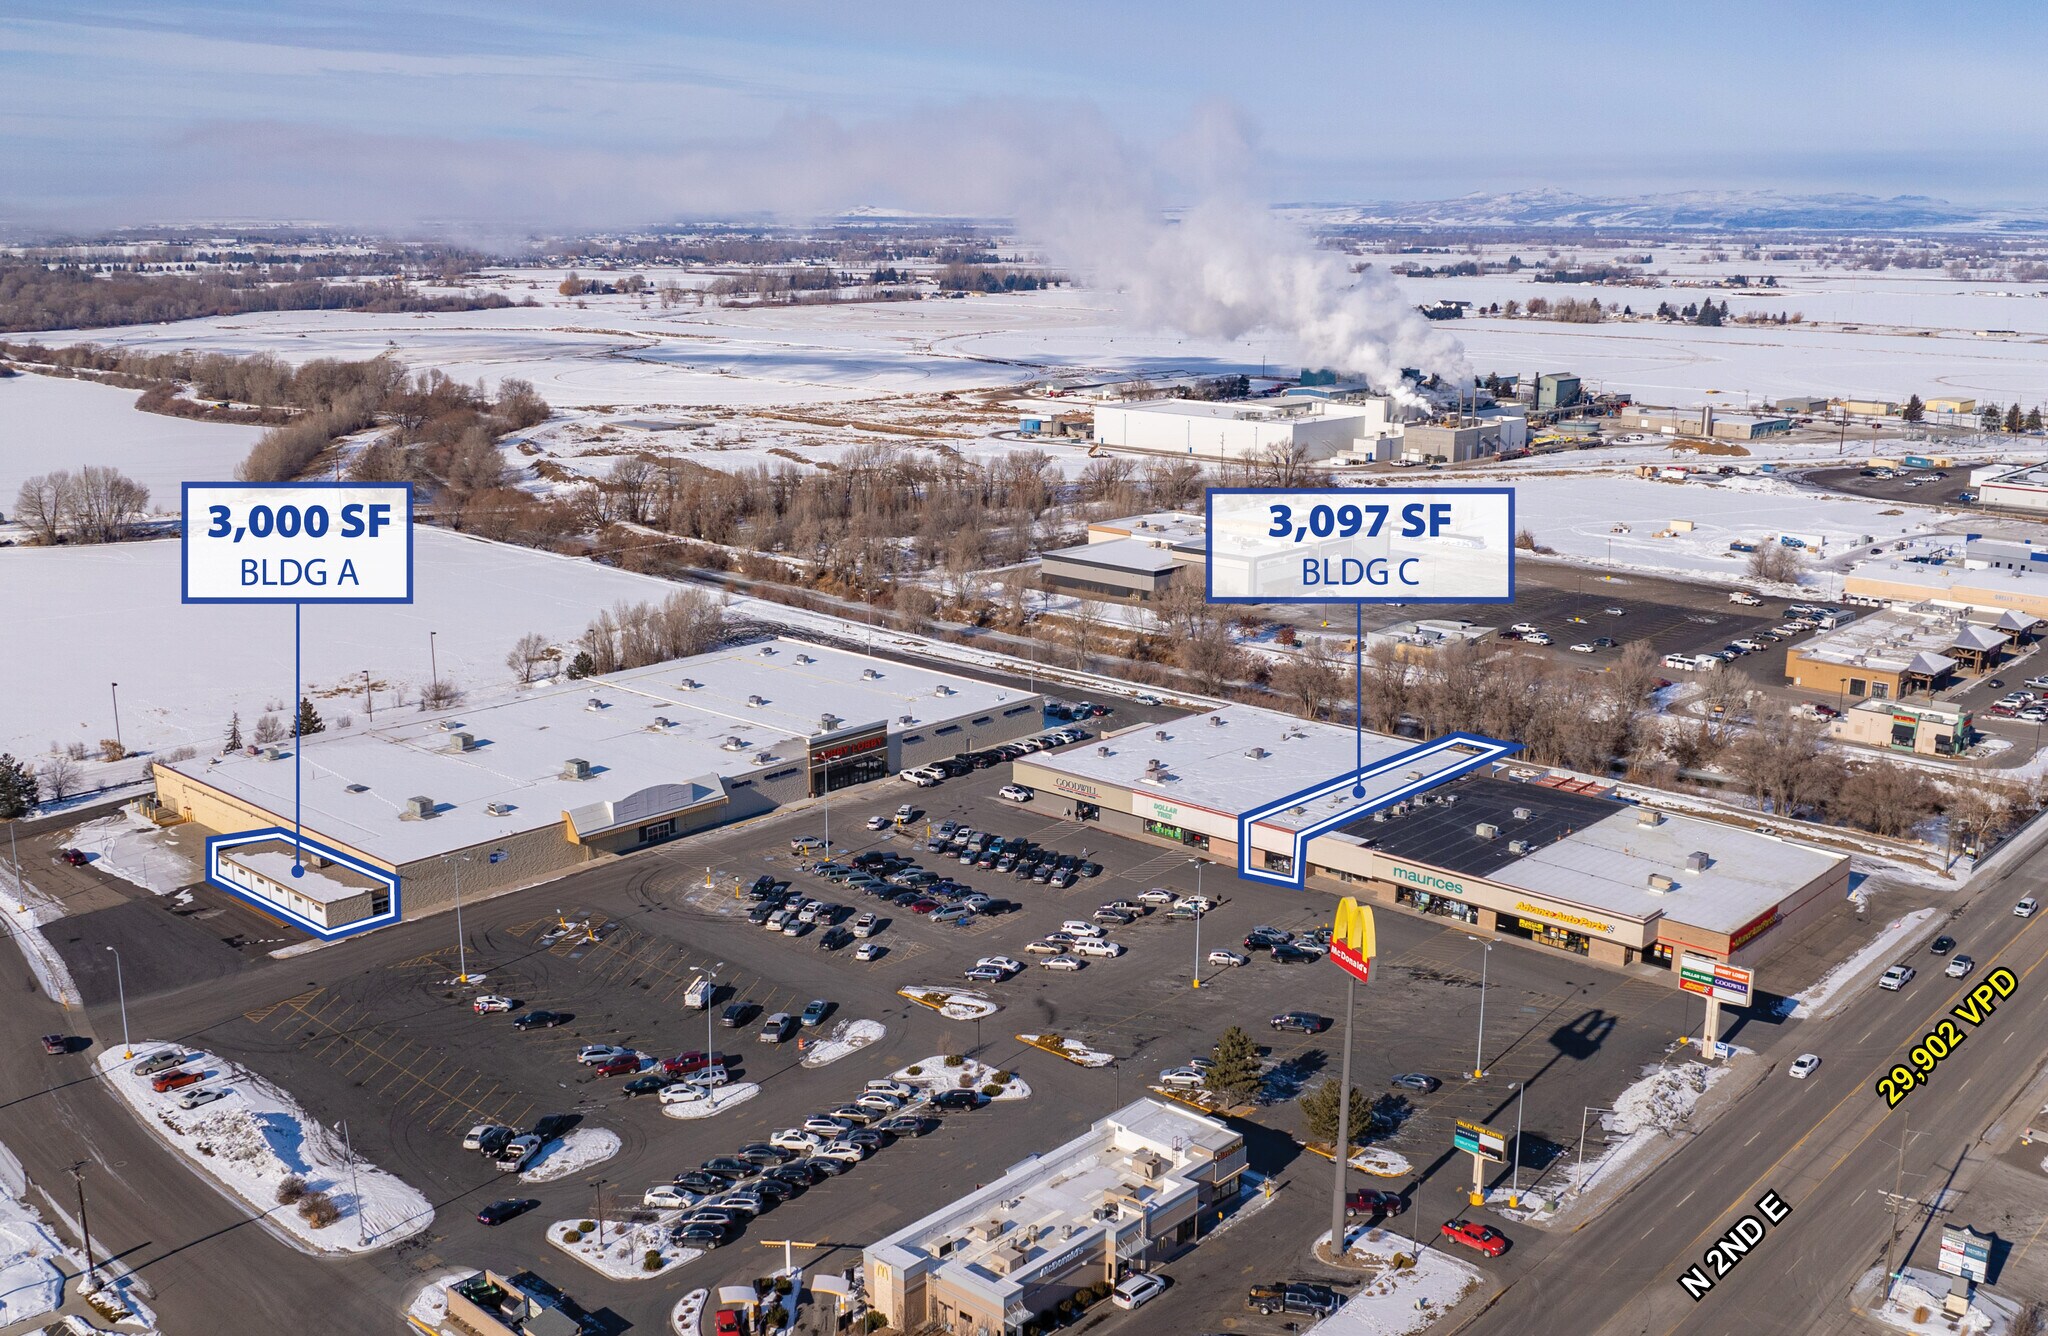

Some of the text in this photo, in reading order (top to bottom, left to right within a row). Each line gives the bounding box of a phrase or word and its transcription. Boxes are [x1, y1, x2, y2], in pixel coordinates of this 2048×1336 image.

[850, 736, 884, 754] LOBBY
[1055, 777, 1097, 795] GOODWILL
[1153, 803, 1178, 815] DOLLAR
[1157, 810, 1173, 821] TREE
[1393, 866, 1463, 895] maurices
[1515, 901, 1609, 933] Advance Auto Parts
[1330, 945, 1368, 975] McDonald's
[1682, 970, 1713, 982] DOLLAR TREE
[1715, 966, 1748, 981] HOBBY LOBBY
[1714, 979, 1747, 992] GOODWILL
[1457, 1120, 1473, 1130] VALLEY
[1486, 1130, 1504, 1140] CENTER
[1039, 1246, 1084, 1278] McDonald's
